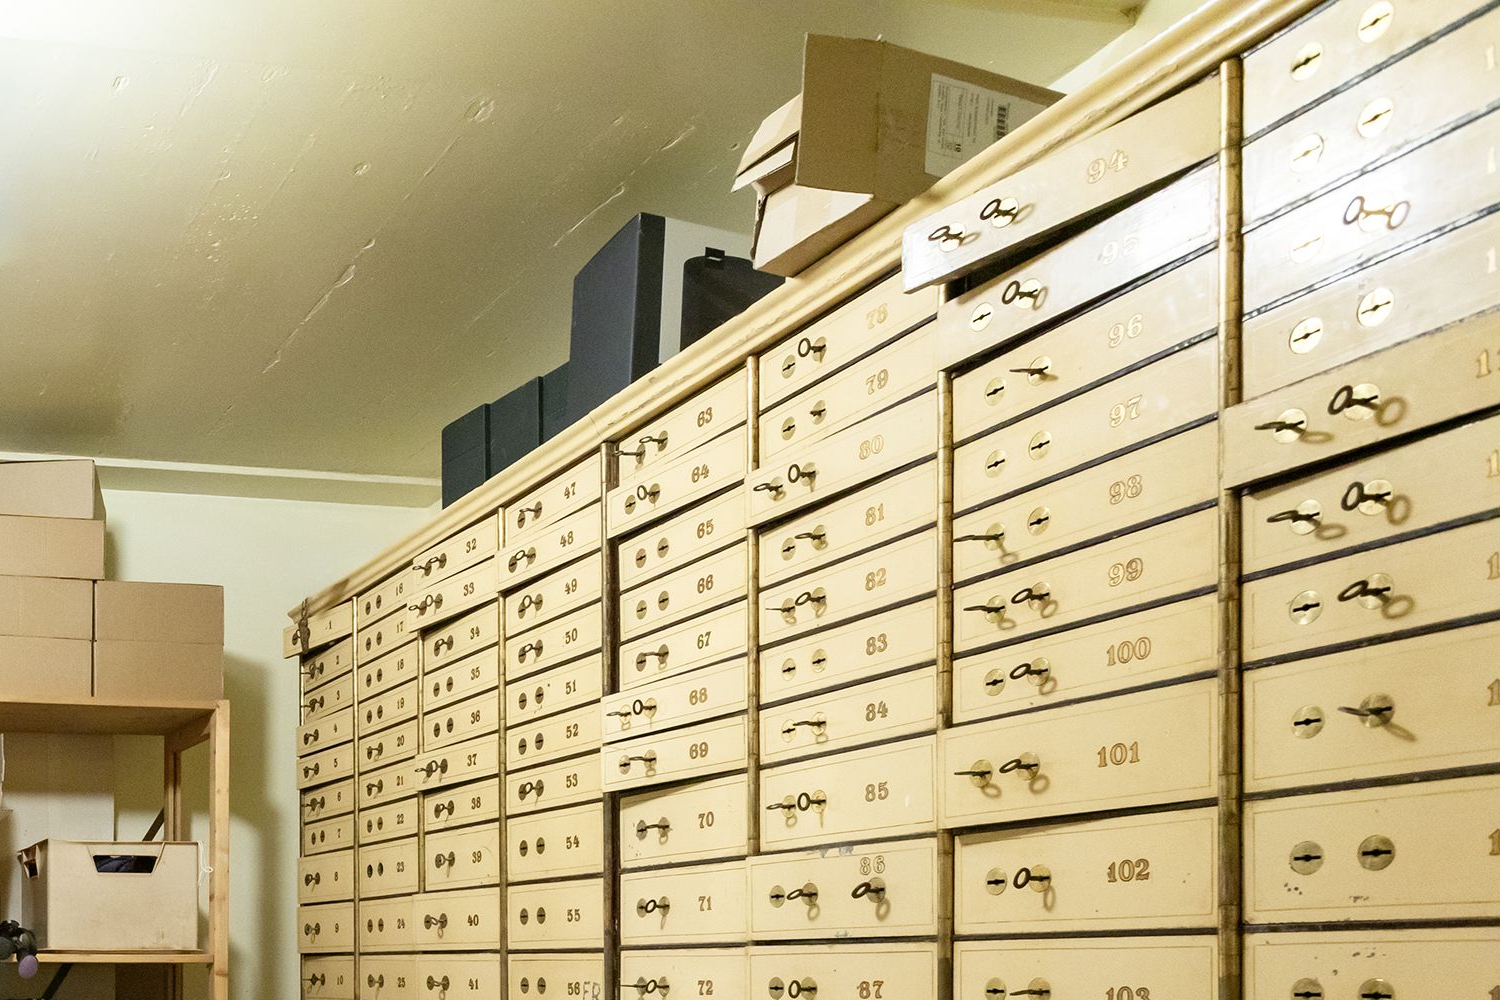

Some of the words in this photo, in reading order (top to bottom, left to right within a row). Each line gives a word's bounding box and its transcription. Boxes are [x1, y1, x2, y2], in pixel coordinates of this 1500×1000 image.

[1086, 149, 1128, 184] 94
[1108, 313, 1142, 348] 96
[865, 368, 888, 395] 79
[696, 406, 712, 428] 63
[1108, 394, 1142, 428] 97
[858, 434, 884, 460] 80
[691, 463, 709, 483] 64
[563, 481, 576, 499] 47
[1108, 474, 1142, 504] 98
[864, 502, 885, 526] 81
[696, 518, 714, 539] 65
[465, 537, 477, 553] 32
[559, 530, 574, 548] 48
[864, 567, 886, 591] 82
[1107, 557, 1143, 586] 99
[463, 581, 474, 597] 33
[564, 578, 578, 595] 49
[696, 573, 714, 594] 66
[469, 625, 480, 640] 34
[564, 627, 578, 644] 50
[697, 630, 711, 649] 67
[865, 632, 887, 655] 83
[1106, 636, 1151, 666] 100
[470, 666, 480, 680] 35
[564, 679, 576, 695] 51
[689, 686, 708, 705] 68
[470, 709, 480, 724] 36
[865, 700, 888, 721] 84
[565, 723, 579, 738] 52
[689, 741, 708, 759] 69
[1096, 741, 1140, 768] 101
[466, 753, 477, 767] 37
[565, 773, 578, 788] 53
[864, 780, 889, 802] 85
[470, 796, 481, 809] 38
[698, 810, 714, 829] 70
[565, 835, 580, 849] 54
[471, 850, 482, 864] 39
[859, 855, 885, 875] 86
[1107, 857, 1150, 882] 102
[698, 895, 712, 911] 71
[467, 913, 479, 926] 40
[566, 908, 580, 922] 55
[468, 978, 479, 990] 41
[567, 981, 580, 995] 56
[697, 979, 714, 996] 72
[858, 980, 884, 1000] 87
